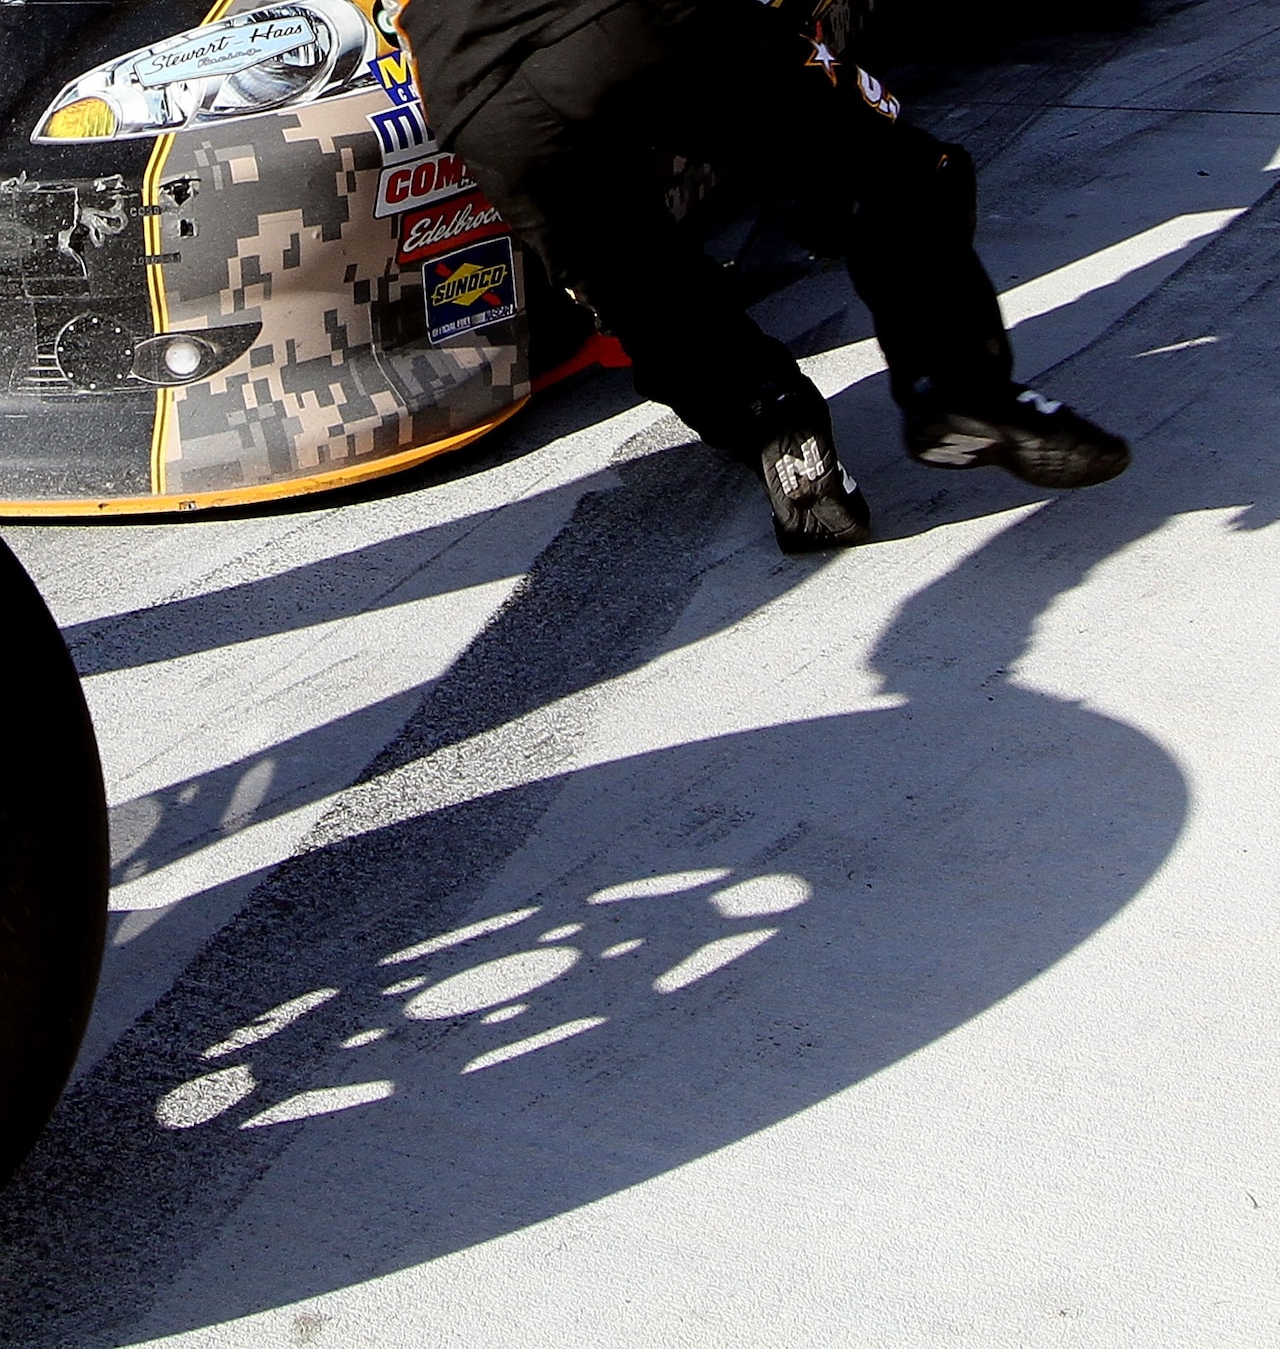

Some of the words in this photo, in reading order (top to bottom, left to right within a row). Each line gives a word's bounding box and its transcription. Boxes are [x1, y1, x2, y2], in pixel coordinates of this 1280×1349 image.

[148, 40, 230, 72] Stewart
[249, 21, 304, 43] Haas
[385, 156, 466, 205] COM
[433, 266, 503, 305] SUNOCO
